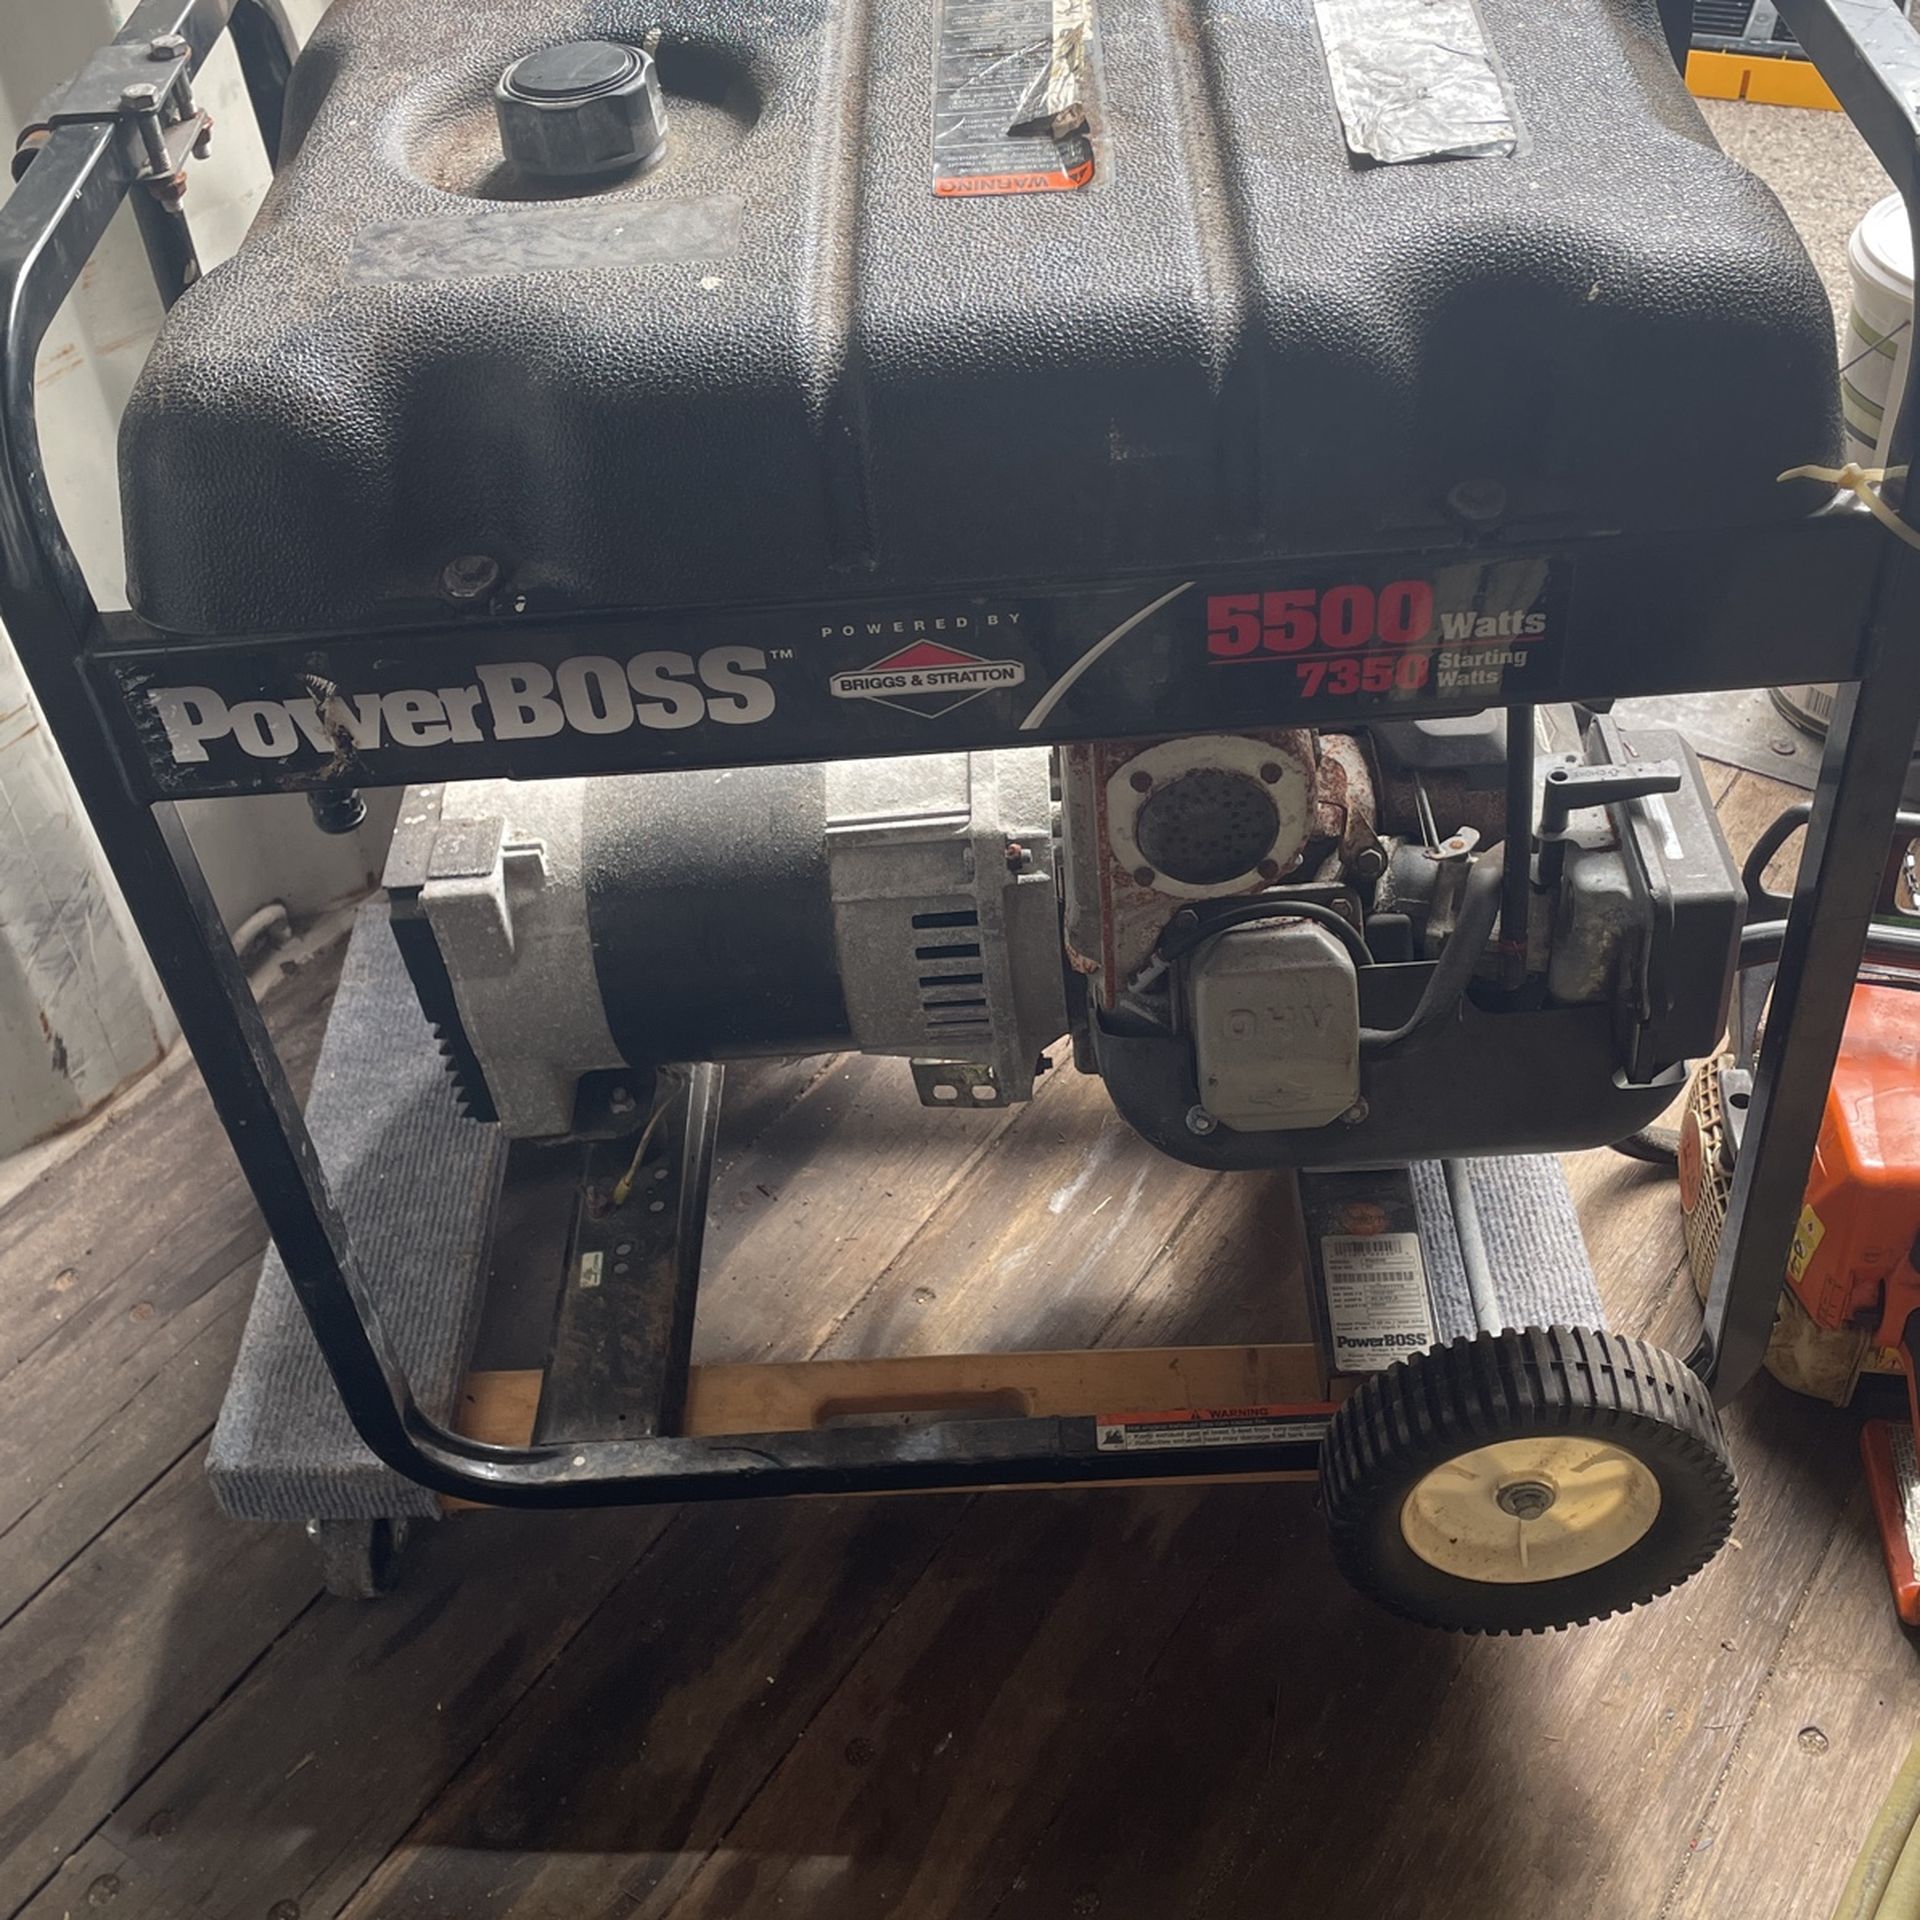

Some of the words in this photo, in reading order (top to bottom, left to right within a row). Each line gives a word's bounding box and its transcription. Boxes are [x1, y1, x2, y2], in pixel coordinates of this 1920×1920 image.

[941, 177, 1048, 193] WARNING
[822, 617, 967, 637] POWERED
[988, 613, 1020, 625] BY
[1207, 579, 1433, 656] 5500
[1441, 609, 1546, 640] Watts
[840, 675, 906, 691] BRIGGS
[911, 677, 923, 687] &
[927, 668, 1015, 685] STRATTON
[1296, 653, 1429, 697] 7350
[1438, 649, 1528, 668] Starting
[1437, 670, 1499, 688] Watts
[147, 645, 776, 763] PowerBOSS
[1336, 1333, 1427, 1348] PowerBOSS
[1210, 1407, 1269, 1418] WARNING
